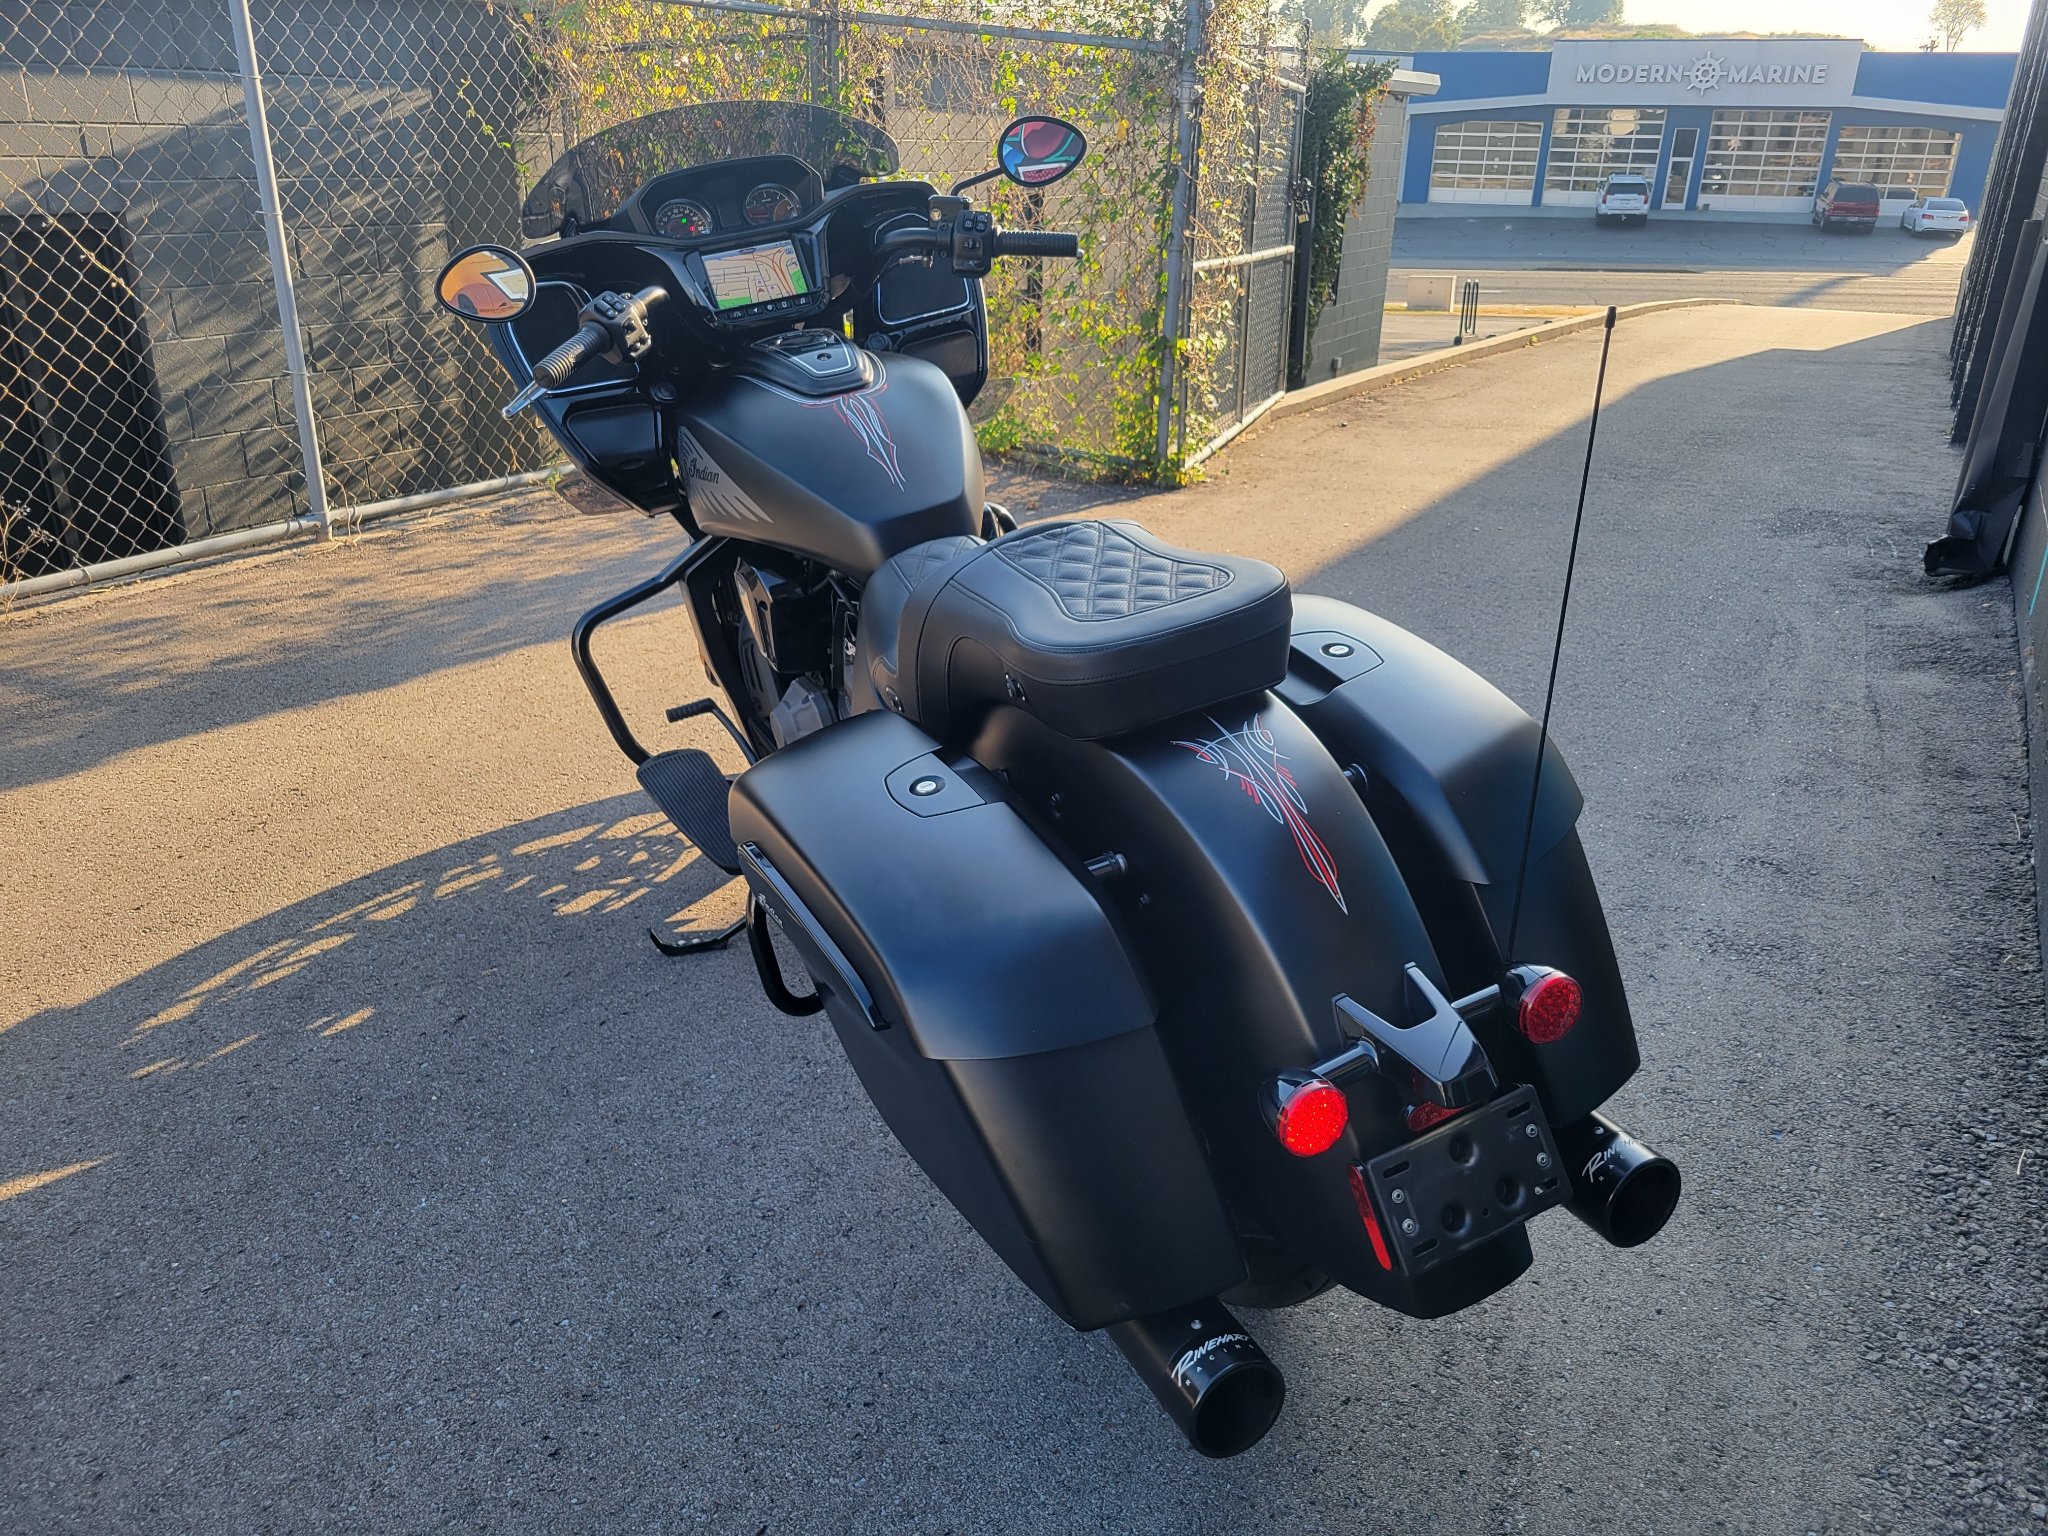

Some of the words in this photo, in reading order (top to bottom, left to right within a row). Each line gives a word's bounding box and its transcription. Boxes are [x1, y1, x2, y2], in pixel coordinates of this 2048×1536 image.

[1576, 64, 1684, 84] MODERN
[1727, 64, 1828, 84] MARINE
[688, 458, 720, 484] Indian
[1170, 1333, 1251, 1387] RINEHART
